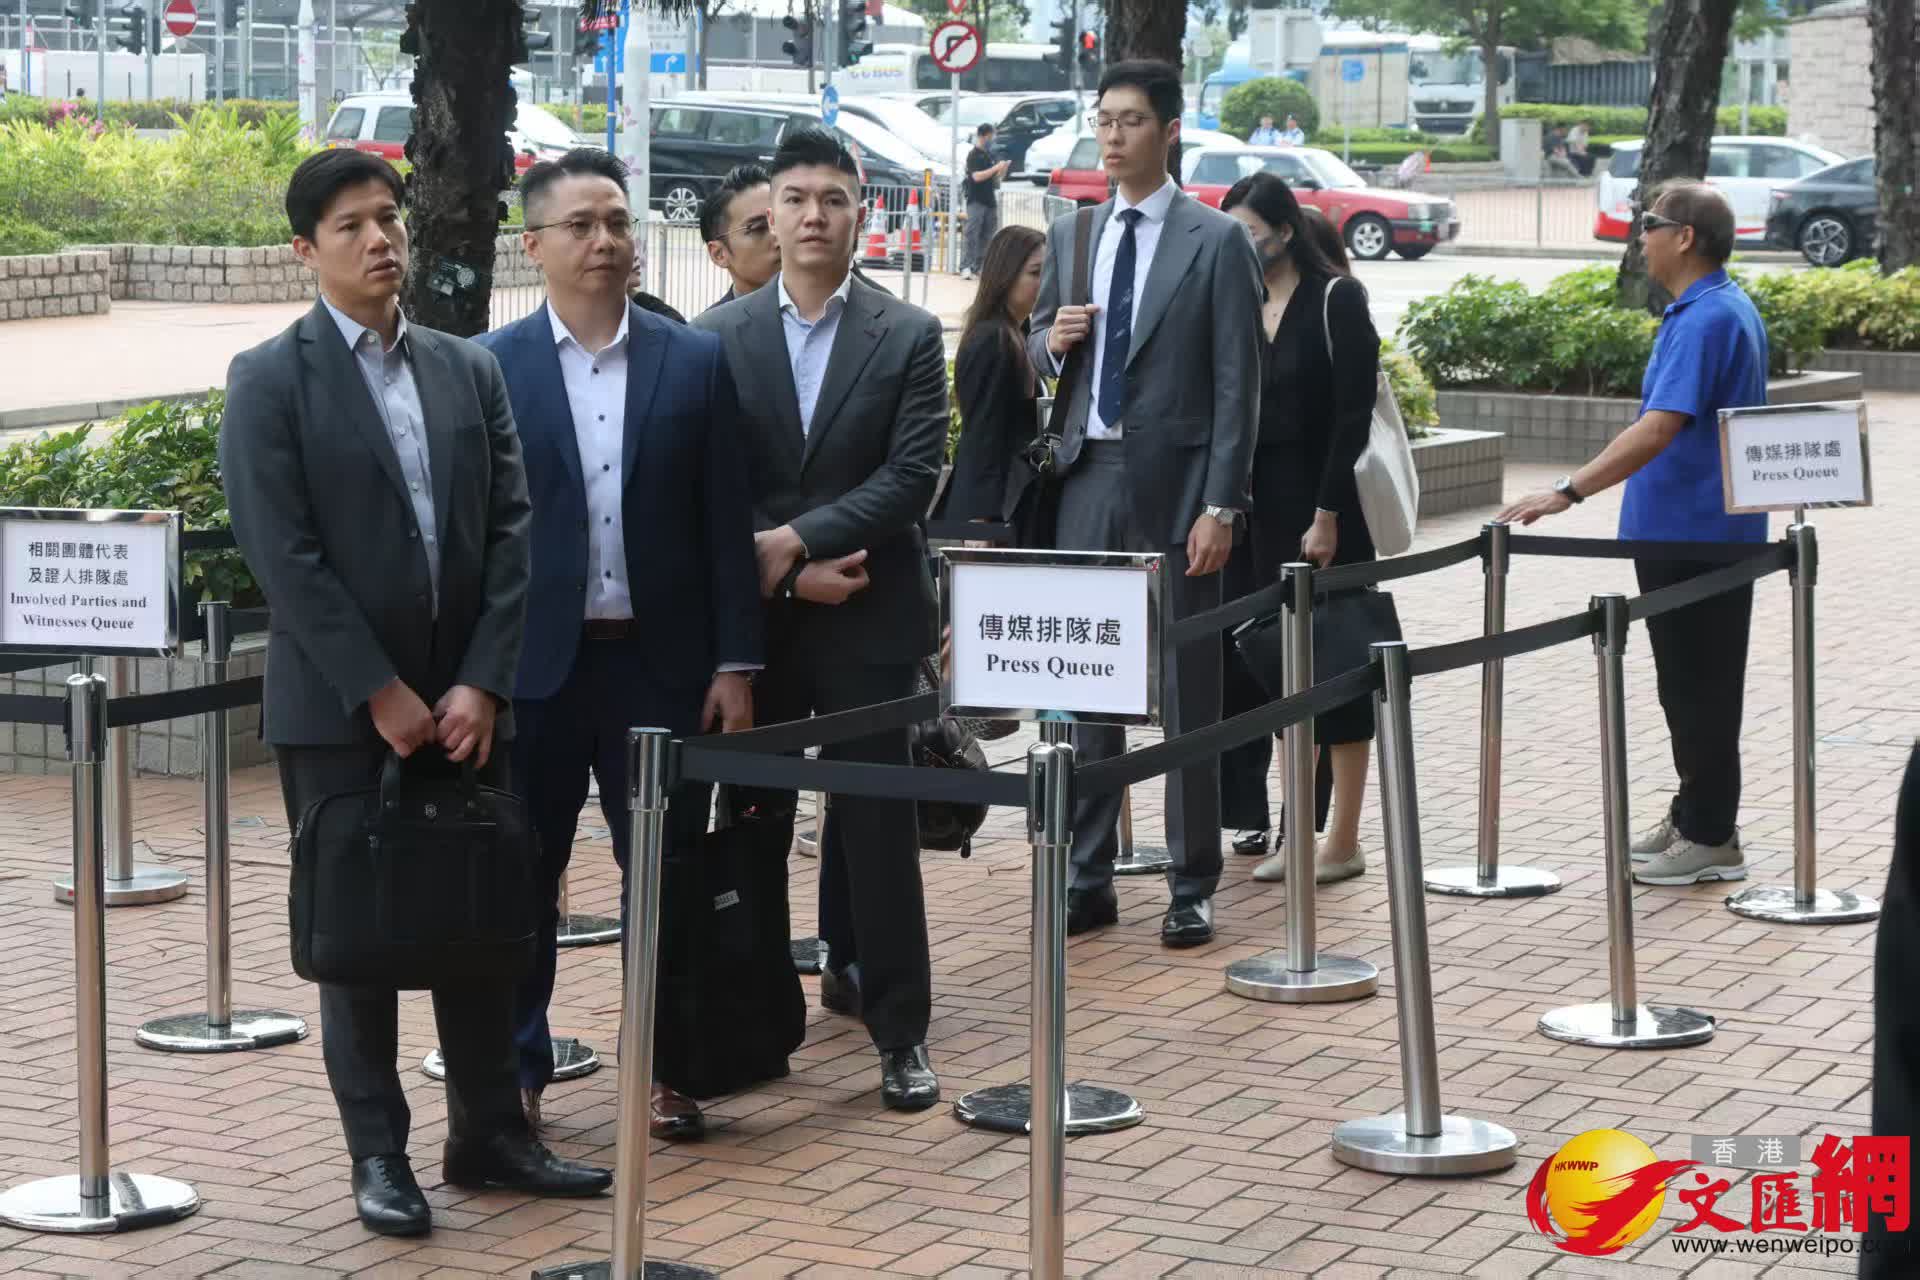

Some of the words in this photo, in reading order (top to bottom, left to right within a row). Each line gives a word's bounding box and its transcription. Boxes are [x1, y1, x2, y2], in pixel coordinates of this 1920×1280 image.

[1745, 440, 1842, 463] 傳媒排隊處
[1752, 468, 1790, 481] Press
[1793, 466, 1839, 480] Queue
[28, 541, 129, 560] 相關團體代表
[28, 567, 129, 586] 及證人排隊處
[10, 592, 66, 606] Involved
[71, 594, 117, 608] Parties
[122, 597, 147, 608] and
[23, 614, 87, 628] Witnesses
[91, 616, 134, 630] Queue
[978, 613, 1121, 646] 傳媒排隊處
[986, 653, 1040, 674] Press
[1047, 656, 1115, 678] Queue
